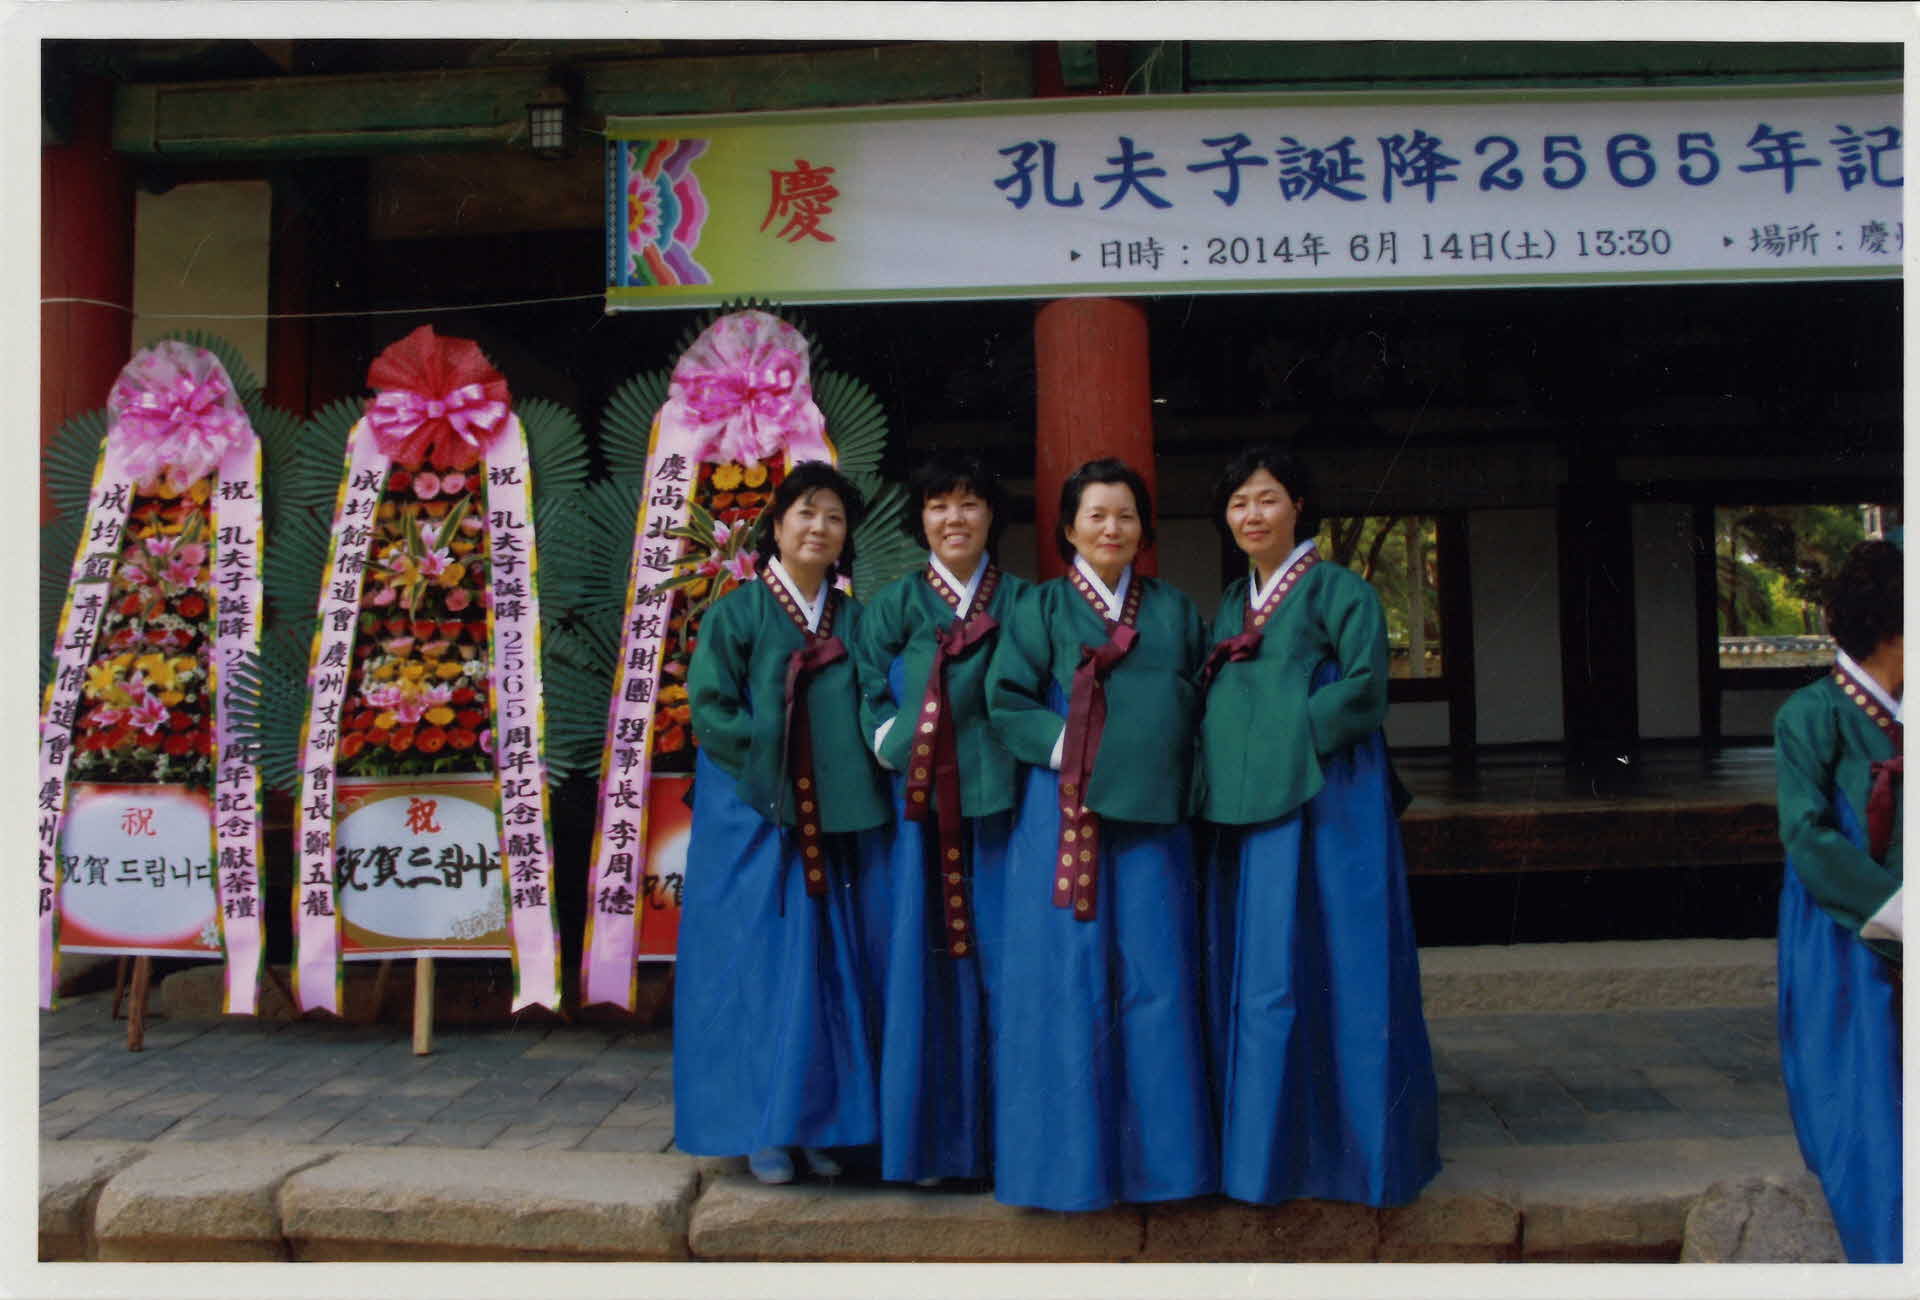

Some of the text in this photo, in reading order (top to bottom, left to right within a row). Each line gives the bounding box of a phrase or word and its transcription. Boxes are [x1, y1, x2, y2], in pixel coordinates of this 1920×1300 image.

[759, 159, 840, 243] 慶
[1207, 231, 1330, 267] 2014年
[1349, 230, 1399, 265] 6月
[1422, 229, 1557, 262] 14日(土)
[1576, 228, 1671, 257] 13:30
[1859, 219, 1905, 255] 慶
[219, 480, 254, 500] 祝
[489, 466, 522, 487] 祝
[121, 807, 157, 837] 祝
[404, 797, 442, 835] 祝
